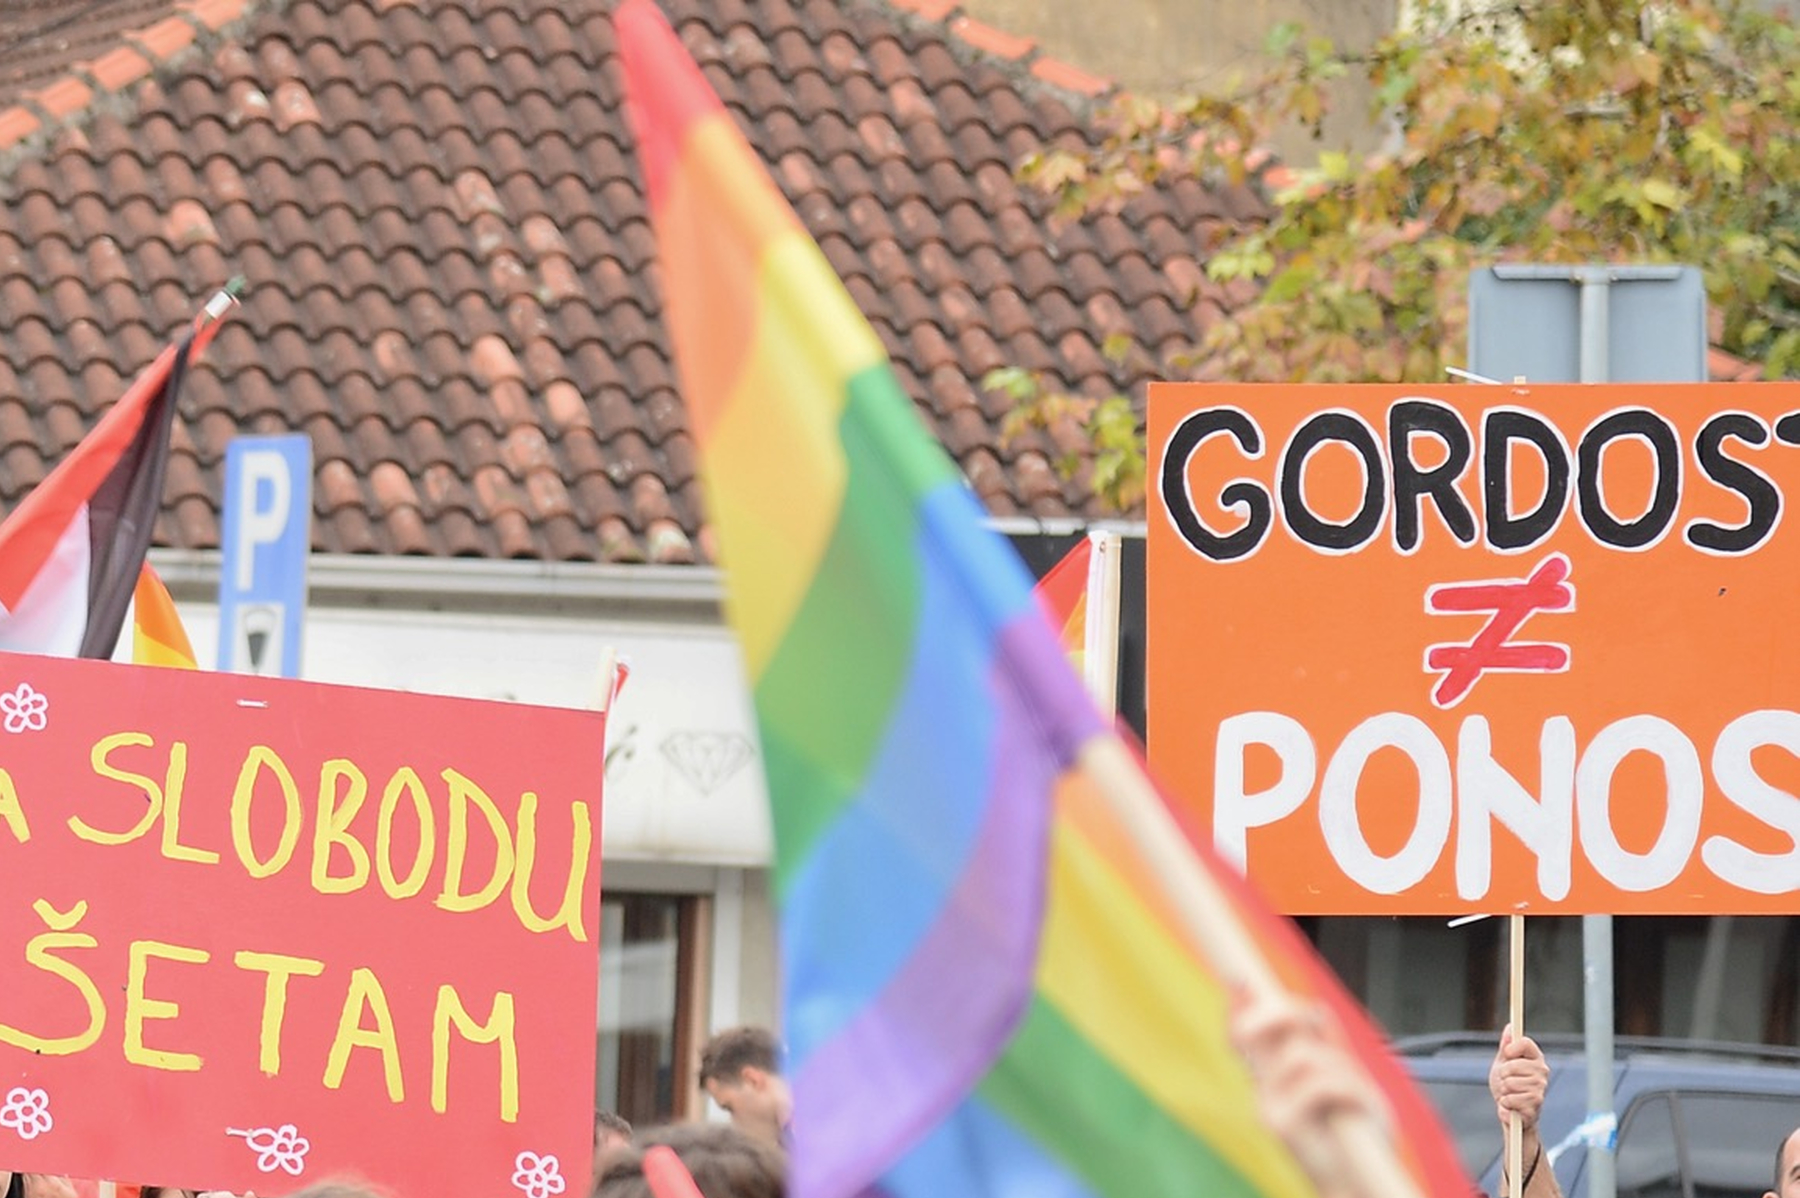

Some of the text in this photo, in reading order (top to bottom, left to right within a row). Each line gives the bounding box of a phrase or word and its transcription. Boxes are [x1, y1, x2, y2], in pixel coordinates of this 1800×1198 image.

[236, 450, 291, 591] P
[66, 732, 592, 943] SLOBODU
[1213, 711, 1800, 903] PONOS
